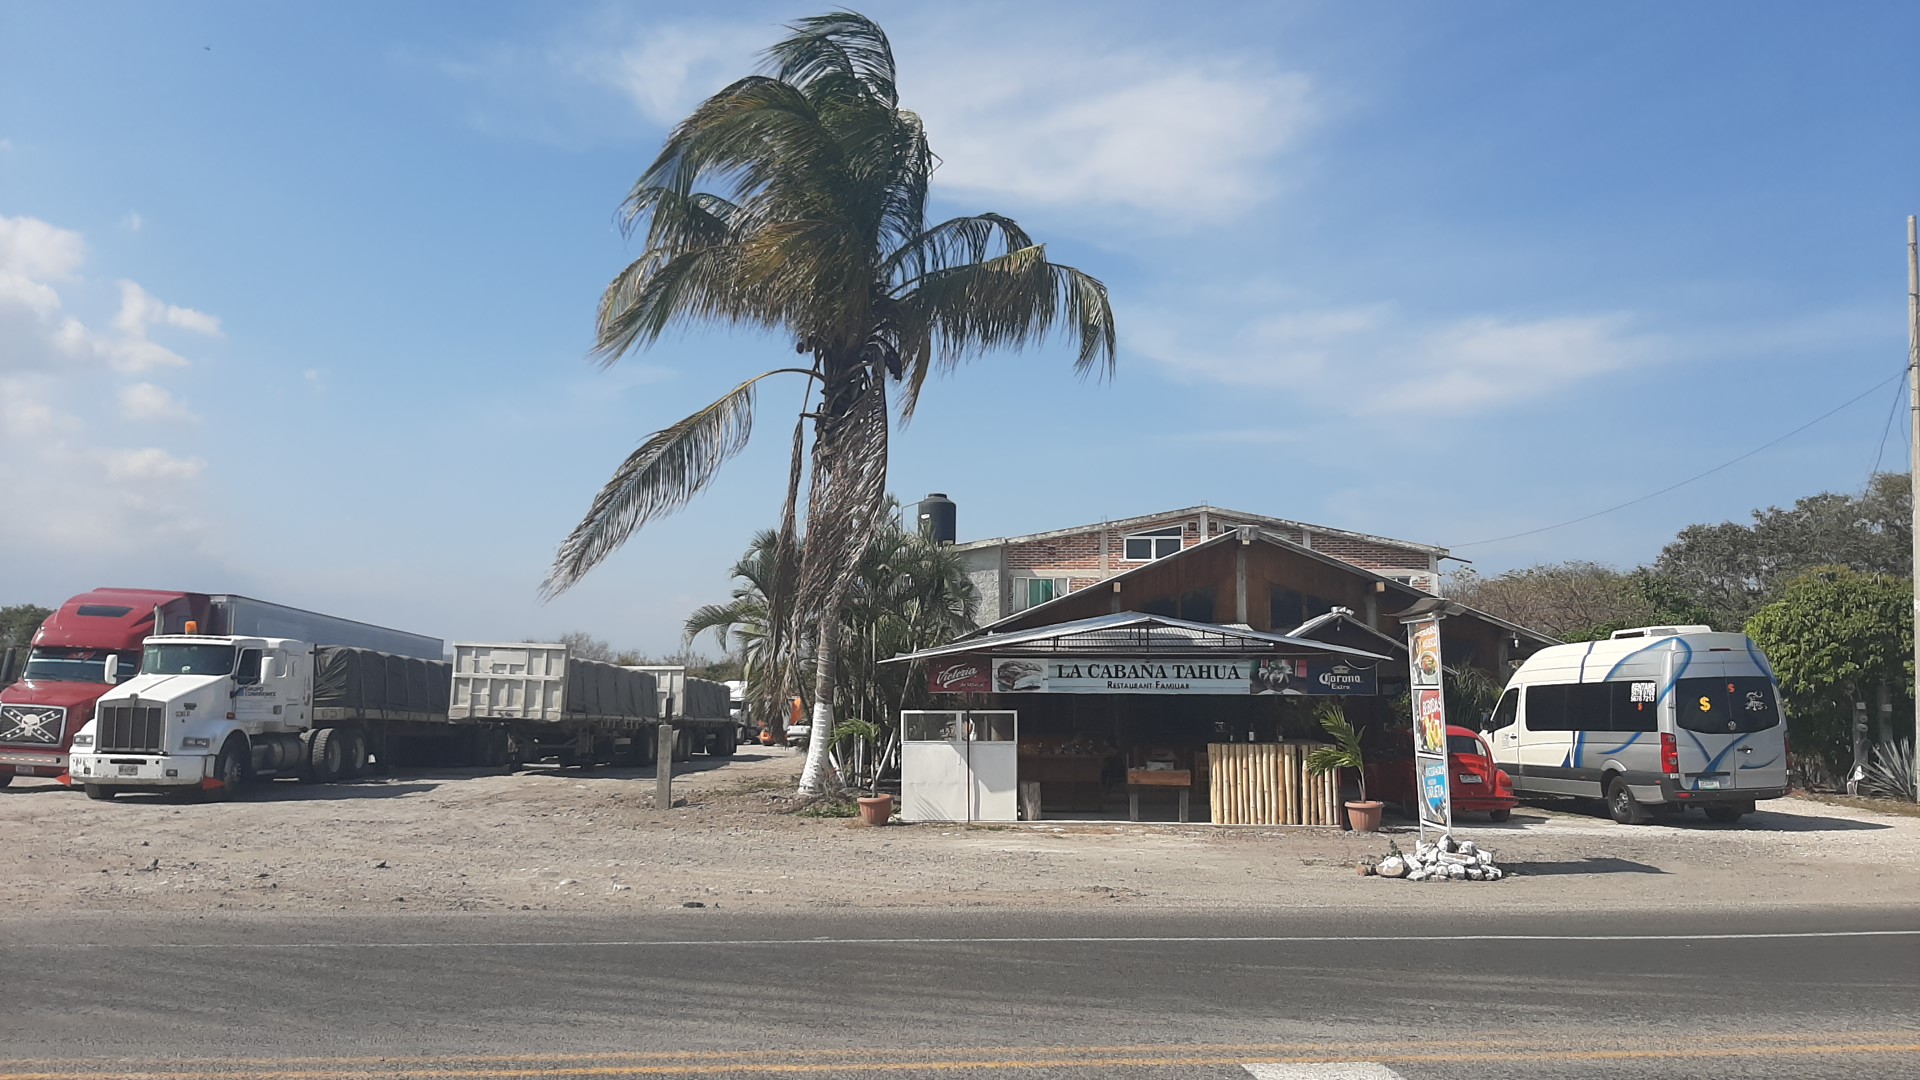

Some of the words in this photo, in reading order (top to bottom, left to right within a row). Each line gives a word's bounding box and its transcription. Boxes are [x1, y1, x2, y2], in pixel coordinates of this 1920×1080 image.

[936, 662, 978, 689] Victoria
[1057, 664, 1082, 679] LA
[1087, 660, 1168, 680] CABAÑA
[1319, 672, 1361, 686] Corona
